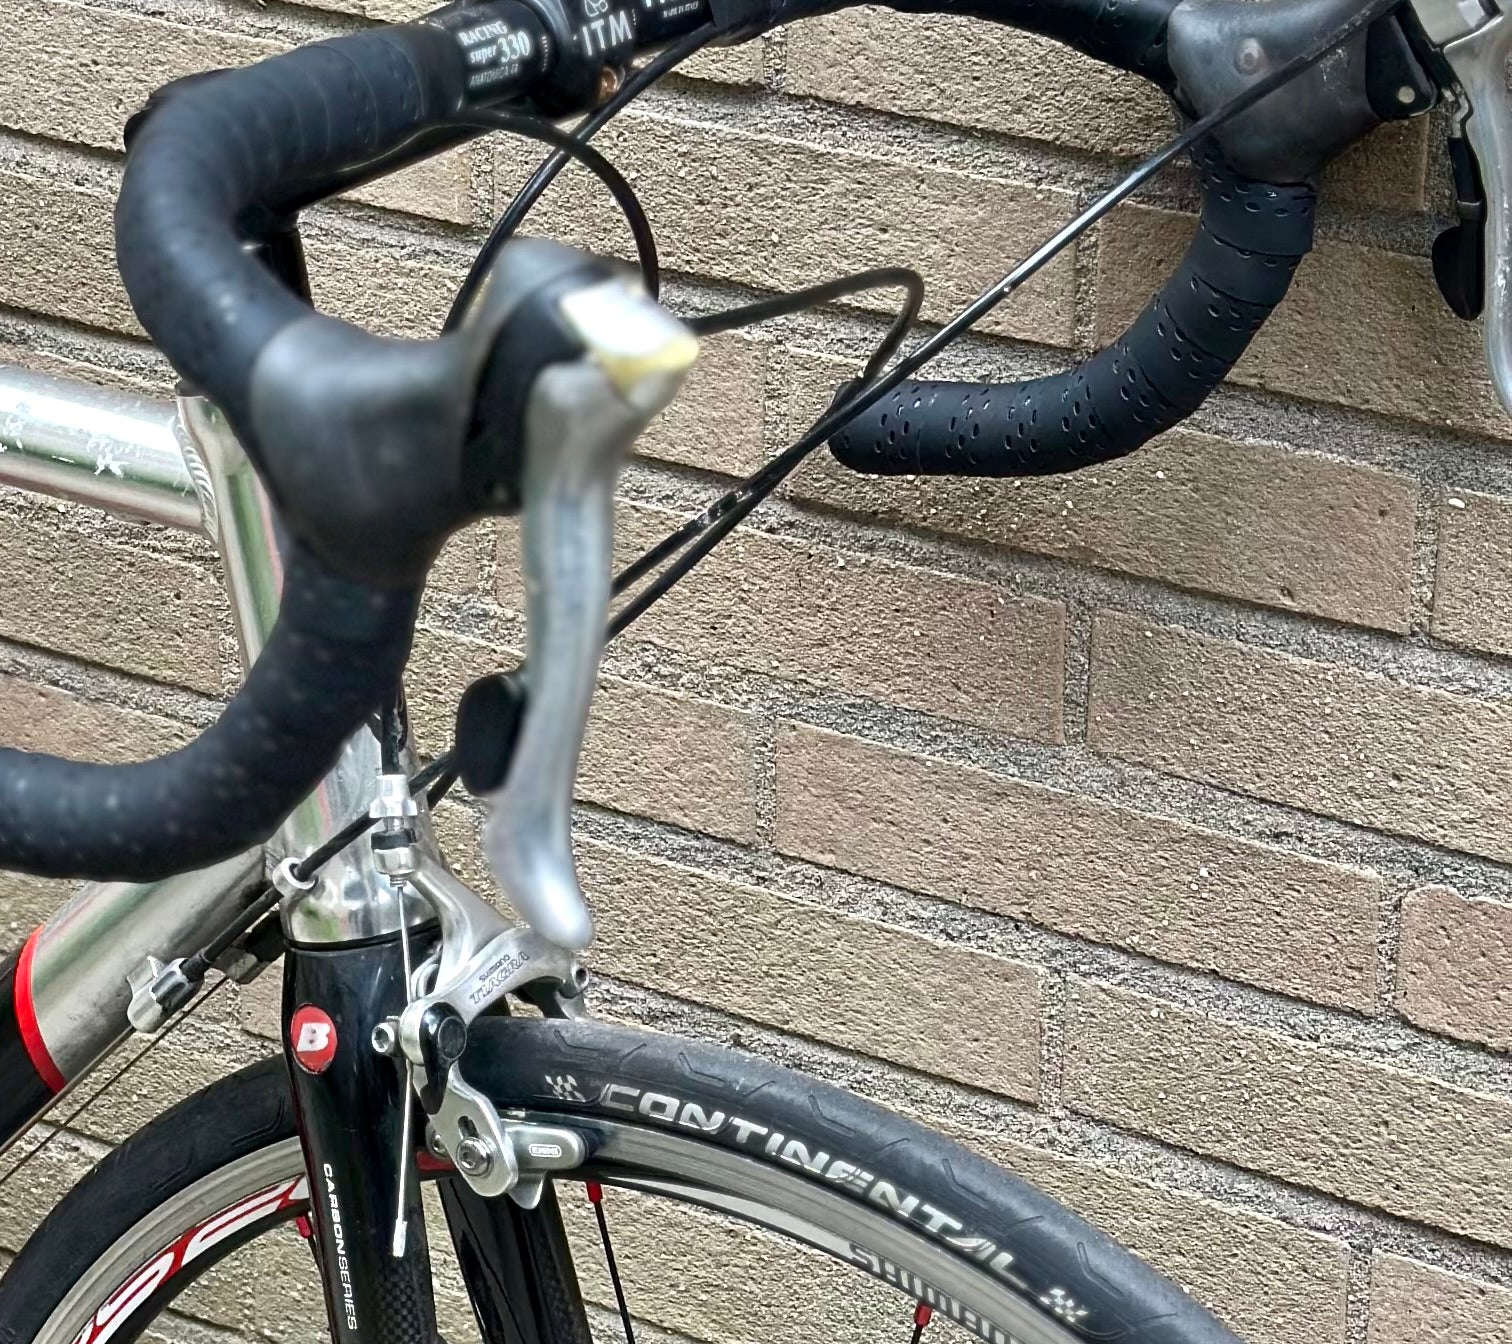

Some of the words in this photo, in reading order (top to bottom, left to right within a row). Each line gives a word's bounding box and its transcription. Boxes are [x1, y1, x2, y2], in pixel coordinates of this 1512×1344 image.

[458, 20, 508, 46] RACING
[470, 44, 497, 64] super
[497, 30, 530, 63] 330
[582, 10, 633, 56] ITM
[469, 951, 530, 1004] TIAGRA
[298, 1022, 331, 1053] B
[599, 1082, 1030, 1290] CONTINENTAL
